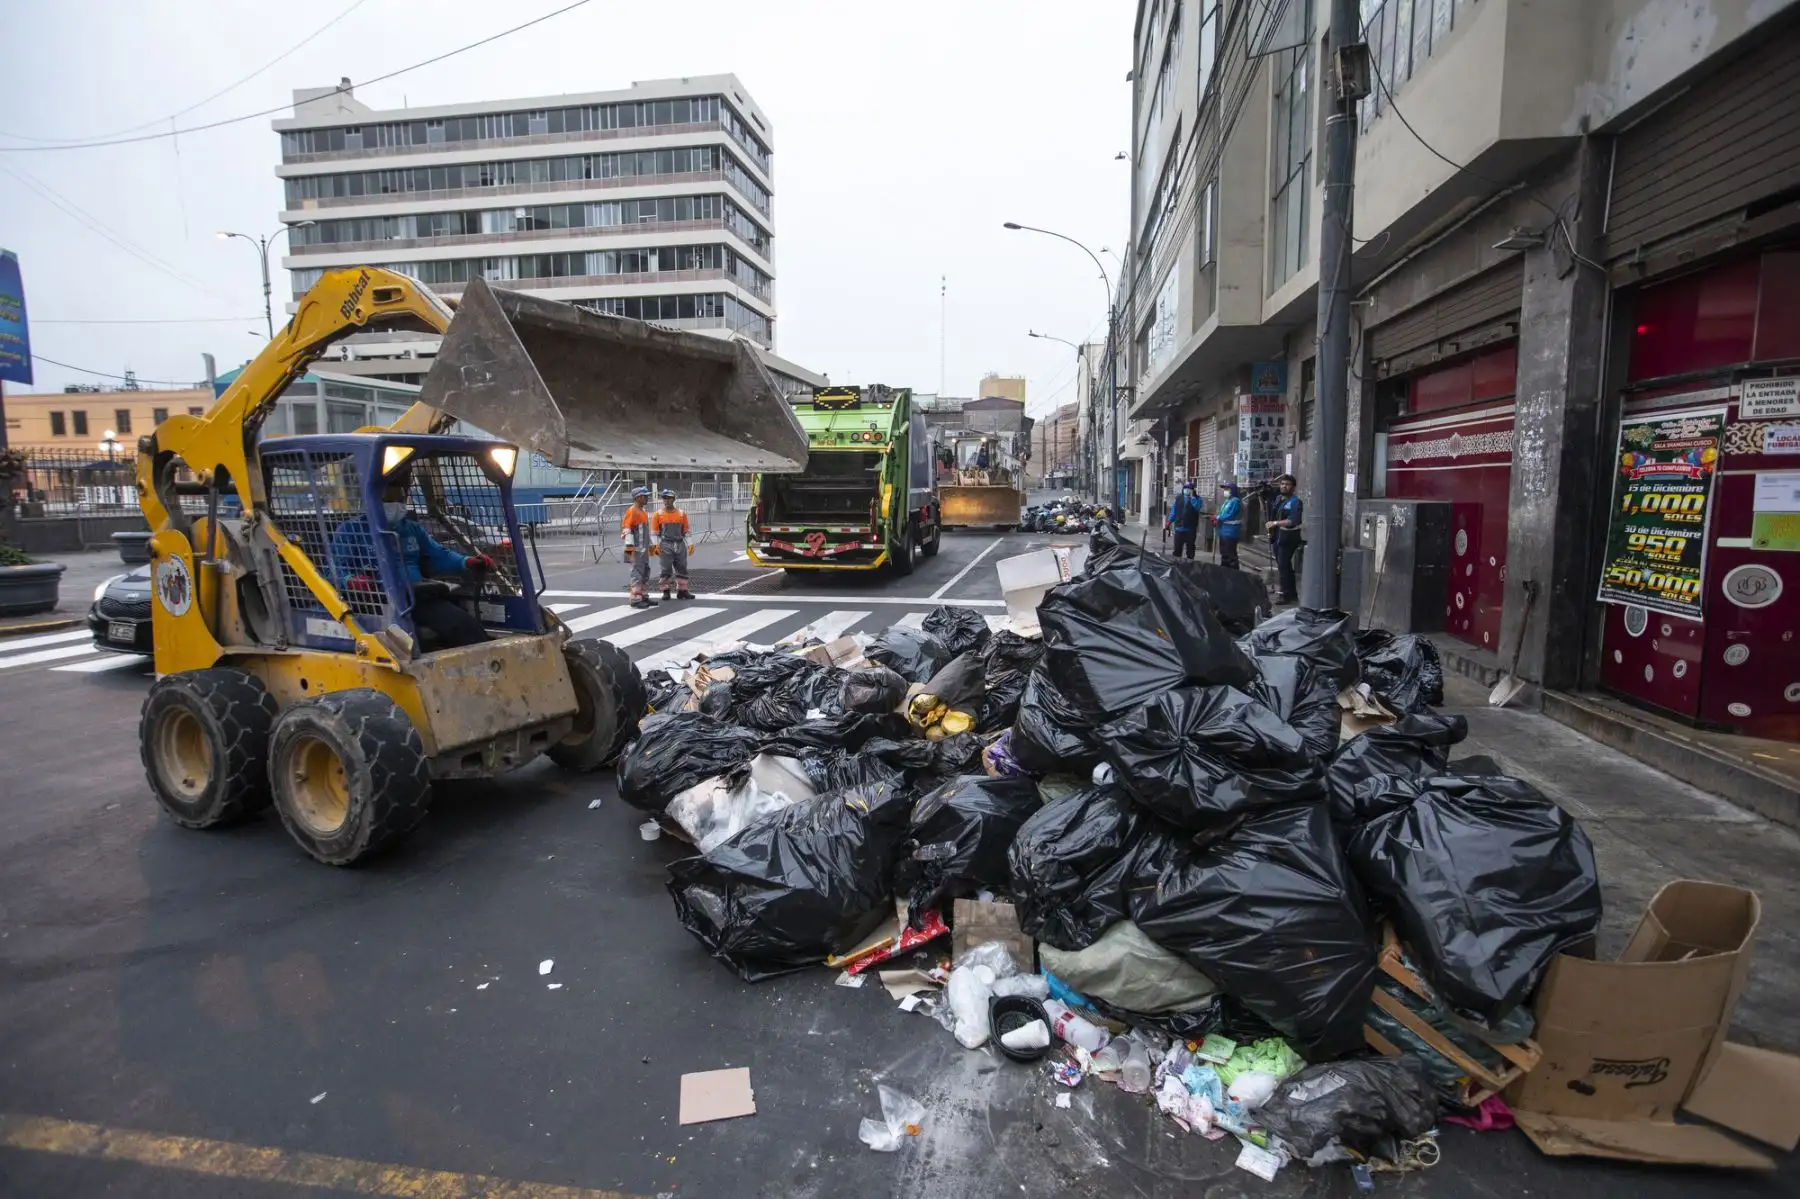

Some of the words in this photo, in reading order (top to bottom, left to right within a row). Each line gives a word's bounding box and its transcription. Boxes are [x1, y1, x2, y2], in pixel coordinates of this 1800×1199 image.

[341, 270, 370, 320] Bobcat
[1749, 381, 1795, 389] PROHIBIDO
[1758, 389, 1796, 398] ENTRADA
[1628, 483, 1639, 492] 15
[1640, 483, 1651, 492] de
[1653, 484, 1704, 492] Diciembre
[1622, 493, 1705, 515] 1,000
[1663, 513, 1702, 522] SOLES
[1624, 525, 1636, 533] 30
[1638, 525, 1649, 534] de
[1650, 526, 1702, 538] Diciembre
[1627, 533, 1687, 555] 950
[1648, 552, 1681, 562] SOLES
[1607, 567, 1701, 597] 50,000
[1660, 591, 1694, 603] SOLES
